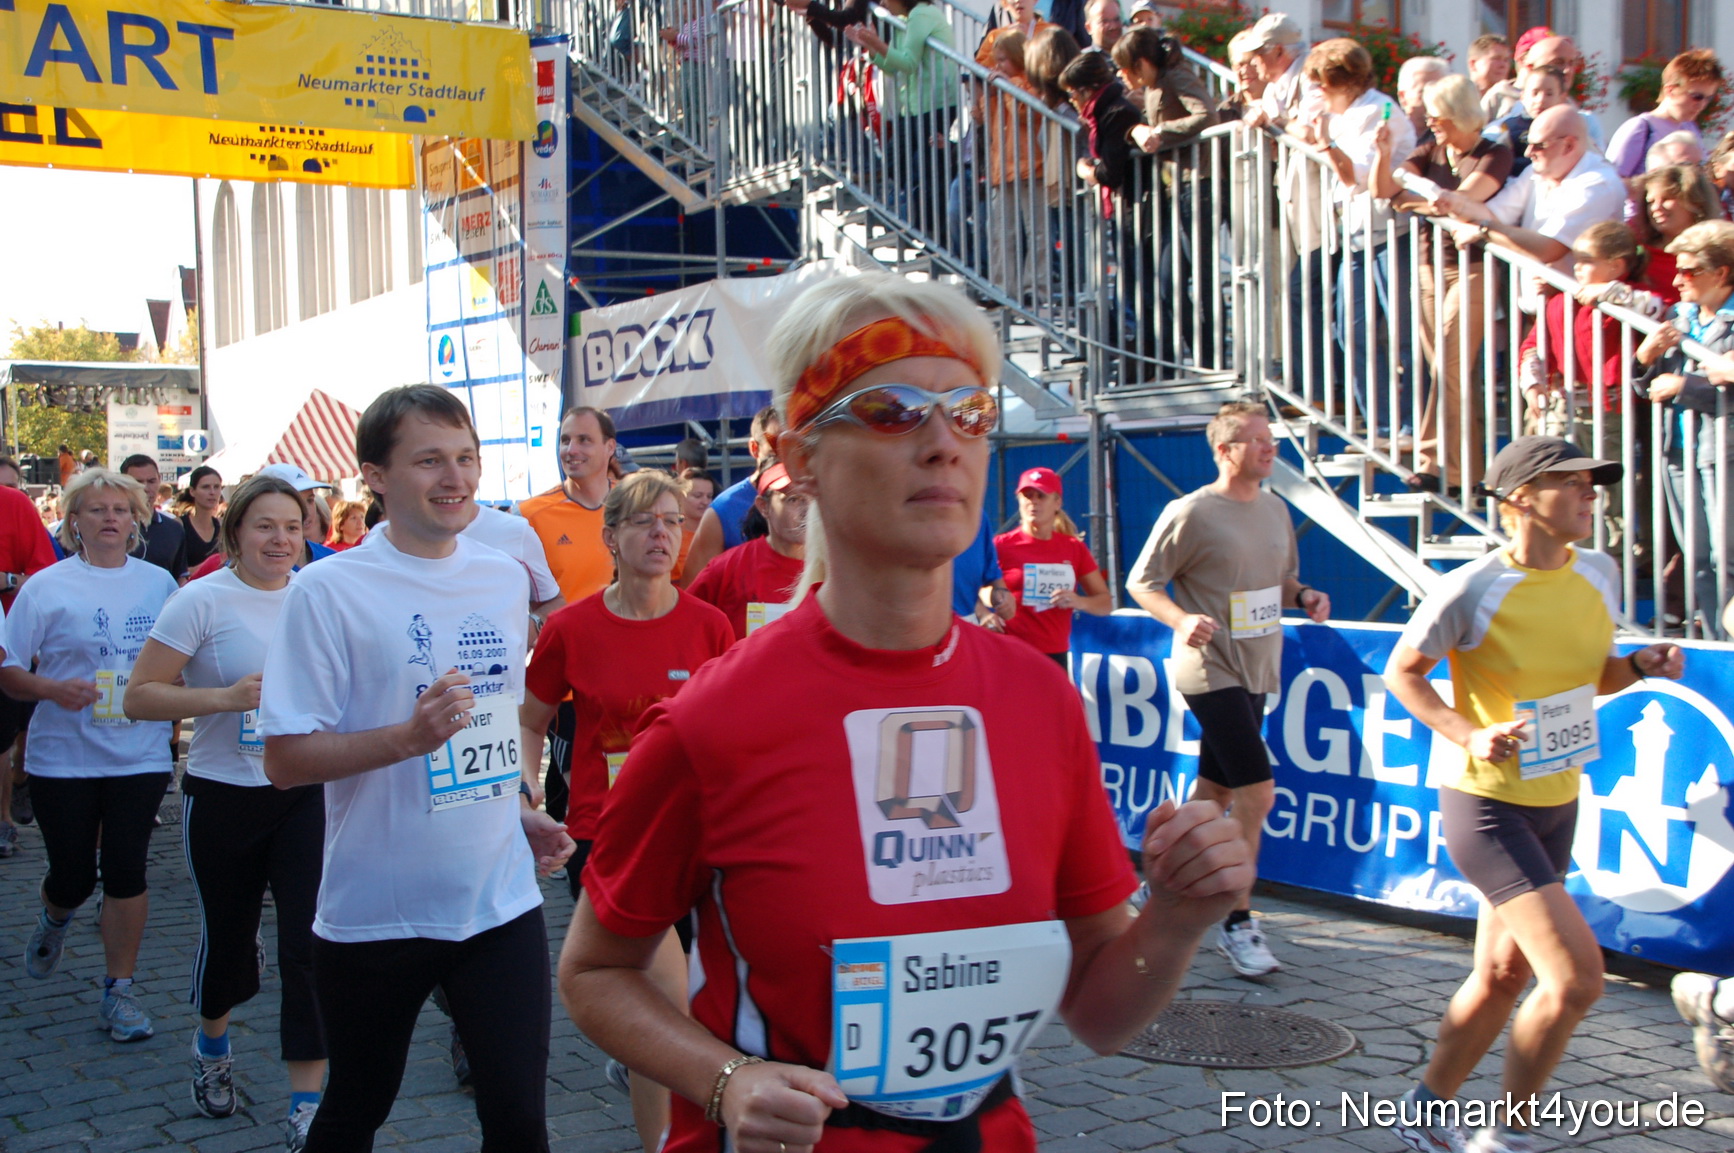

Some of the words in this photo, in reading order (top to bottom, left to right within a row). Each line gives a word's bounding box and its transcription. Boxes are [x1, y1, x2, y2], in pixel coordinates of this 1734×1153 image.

[0, 0, 235, 95] ART
[297, 73, 403, 96] Neumarkter
[408, 79, 486, 103] Stadtlauf
[208, 132, 301, 150] Neumarkter
[306, 138, 375, 155] Stadtlauf
[461, 211, 491, 231] MERZ
[583, 308, 716, 388] BOCK
[1251, 603, 1278, 622] 1209
[457, 647, 508, 661] 16.09.2007
[245, 713, 252, 724] D
[1546, 719, 1592, 752] 3095
[461, 737, 518, 776] 2716
[872, 829, 976, 869] QUINN
[909, 860, 995, 897] plastics
[903, 952, 1000, 994] Sabine
[846, 1022, 861, 1051] D
[904, 1008, 1043, 1079] 3057
